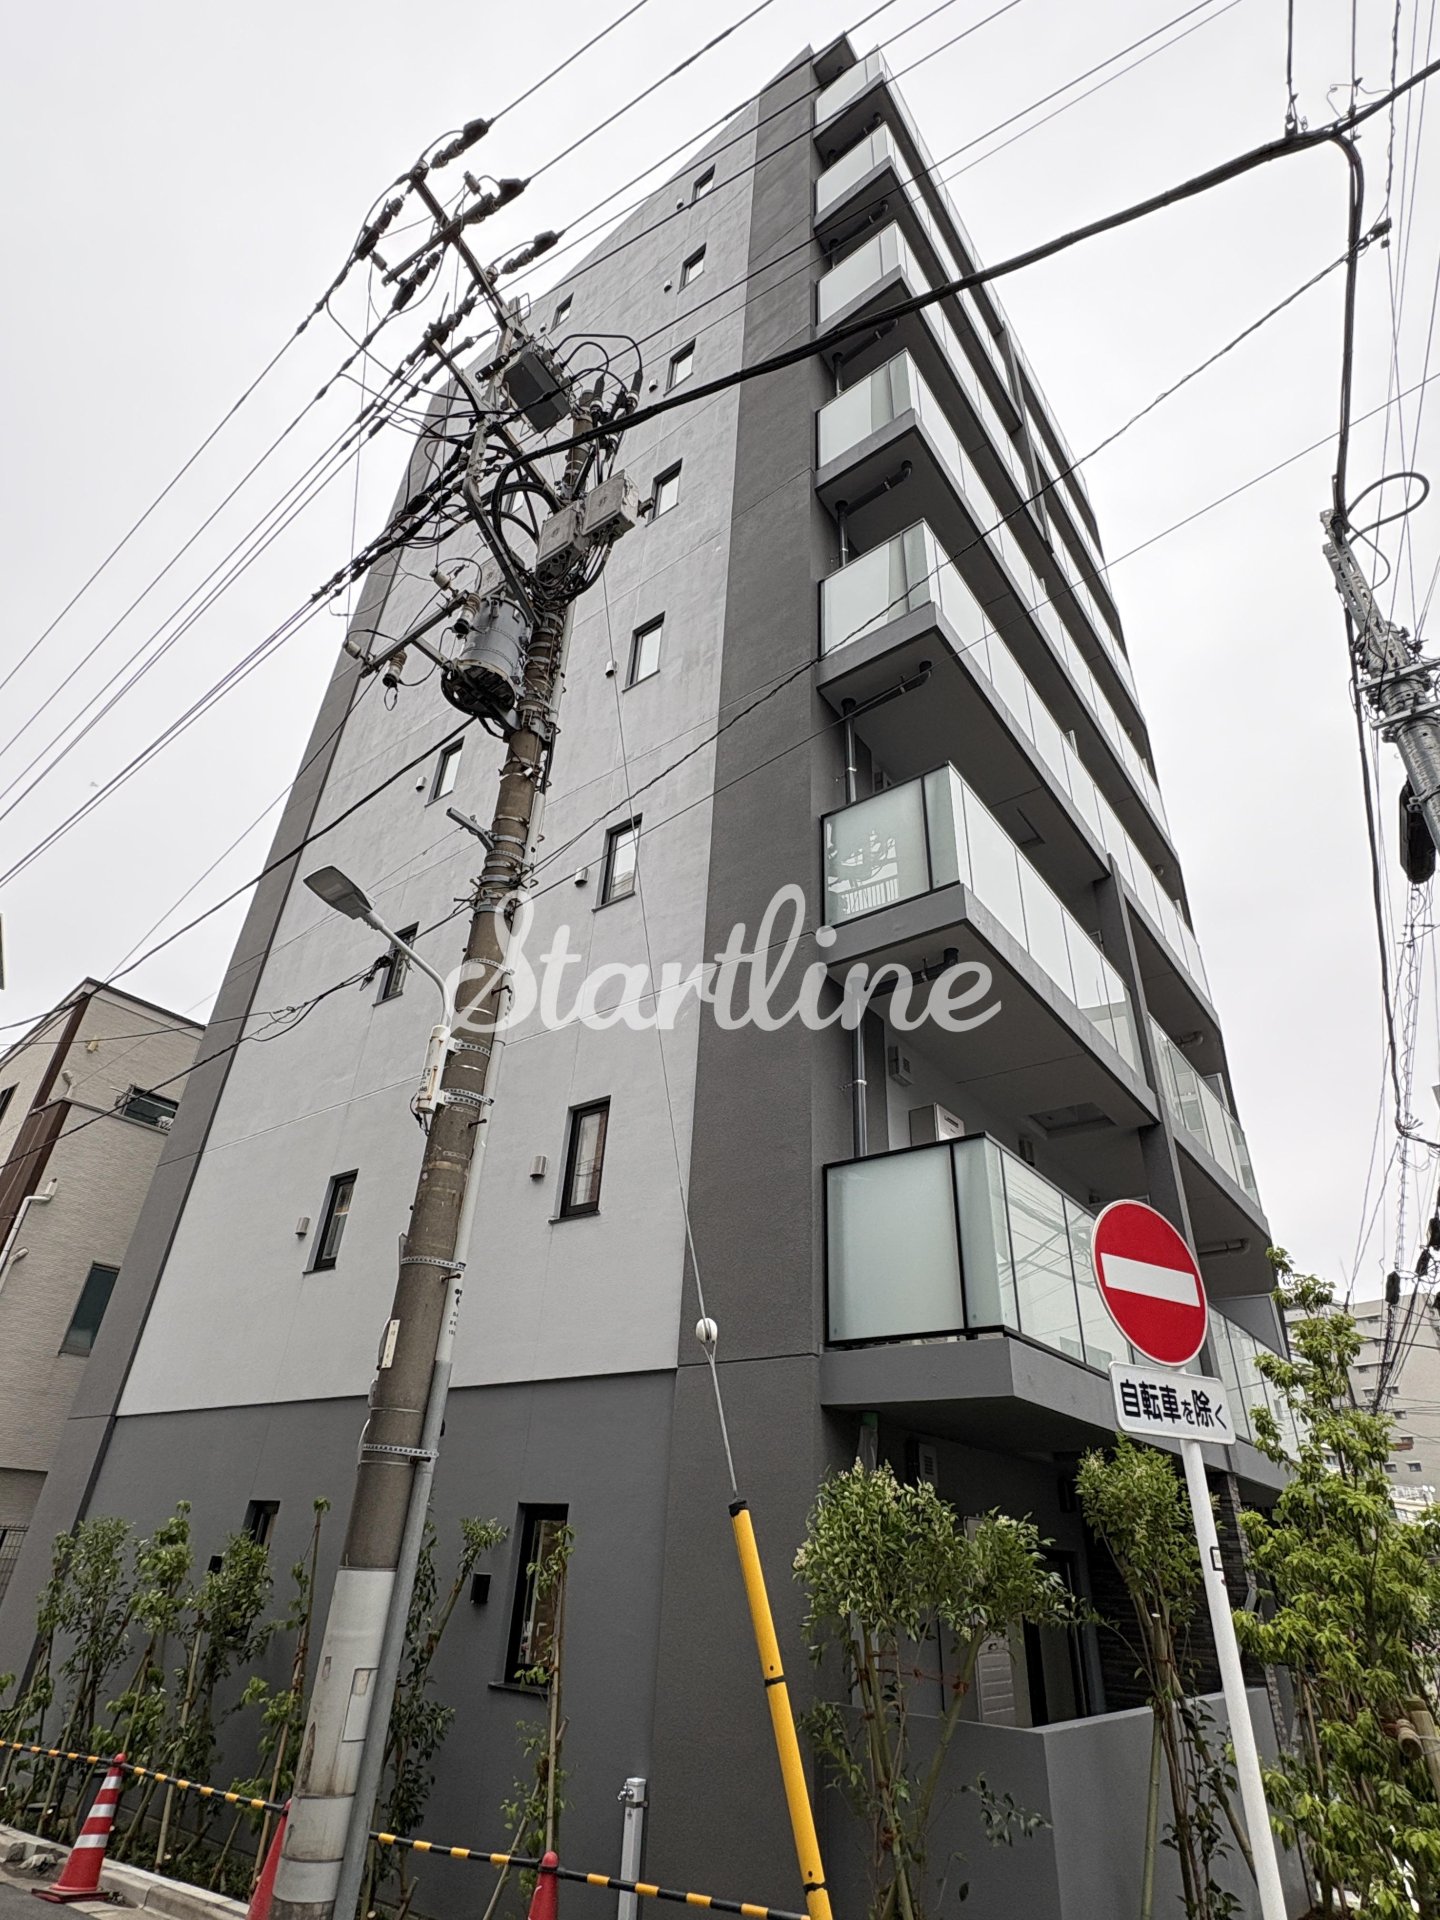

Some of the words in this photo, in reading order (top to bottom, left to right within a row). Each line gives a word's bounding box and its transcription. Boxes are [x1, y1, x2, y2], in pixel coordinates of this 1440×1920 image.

[1120, 1379, 1227, 1430] 自転車を除く
